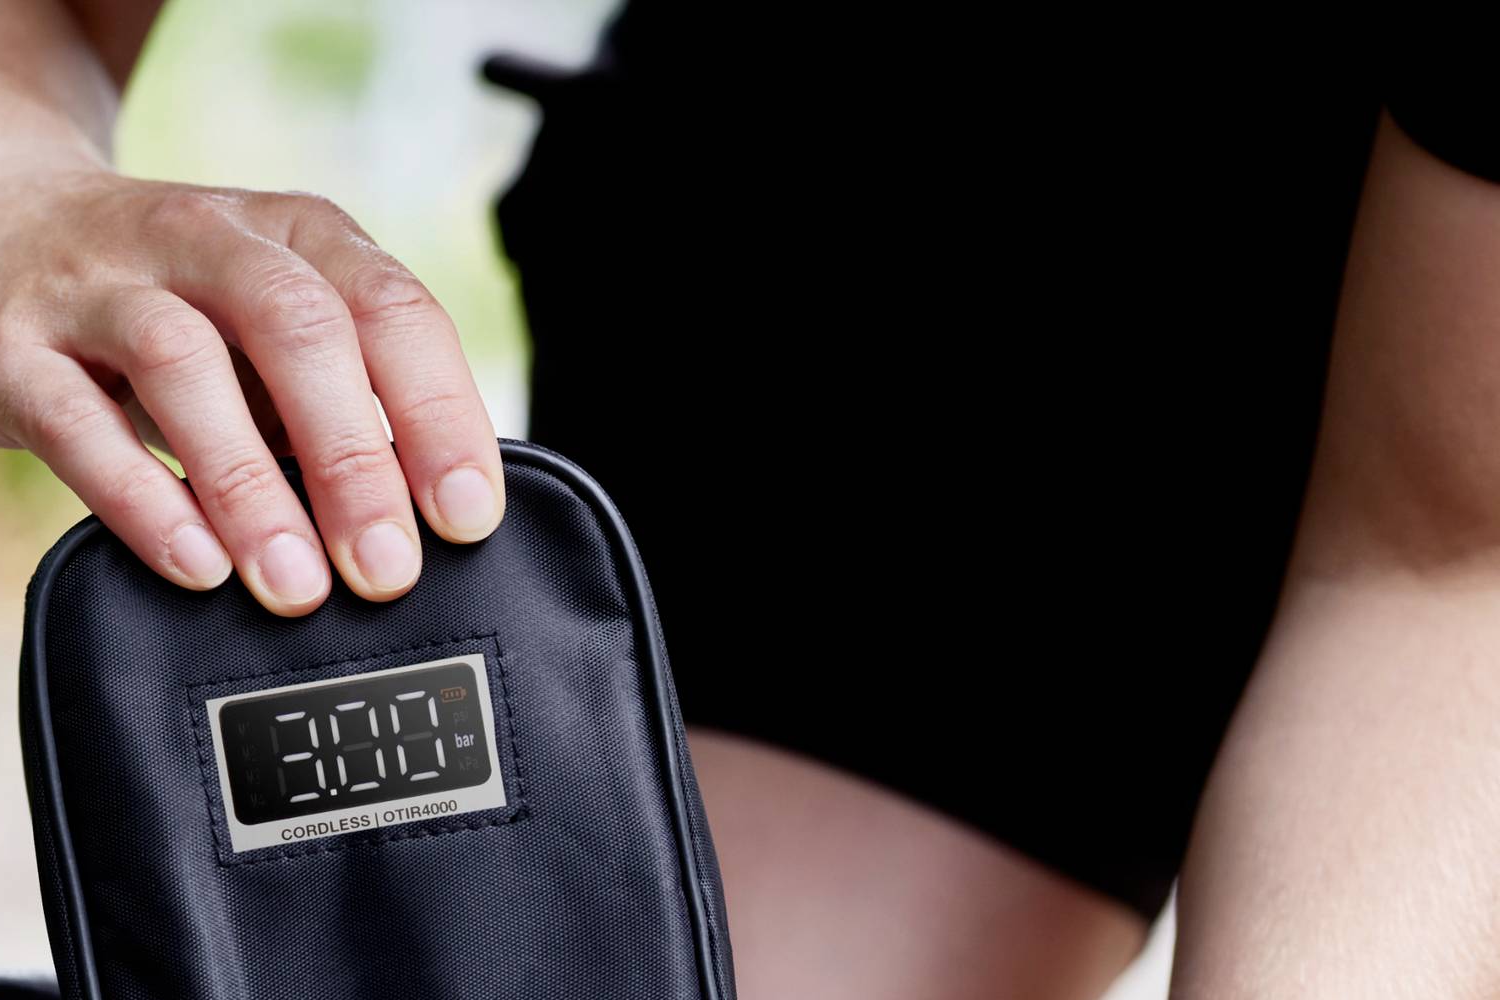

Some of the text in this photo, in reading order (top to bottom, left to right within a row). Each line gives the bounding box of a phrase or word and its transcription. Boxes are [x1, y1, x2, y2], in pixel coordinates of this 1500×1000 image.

[275, 690, 446, 803] 3.00
[454, 732, 475, 749] bar
[280, 814, 371, 842] CORDLESS
[383, 799, 458, 823] OTIR4000
